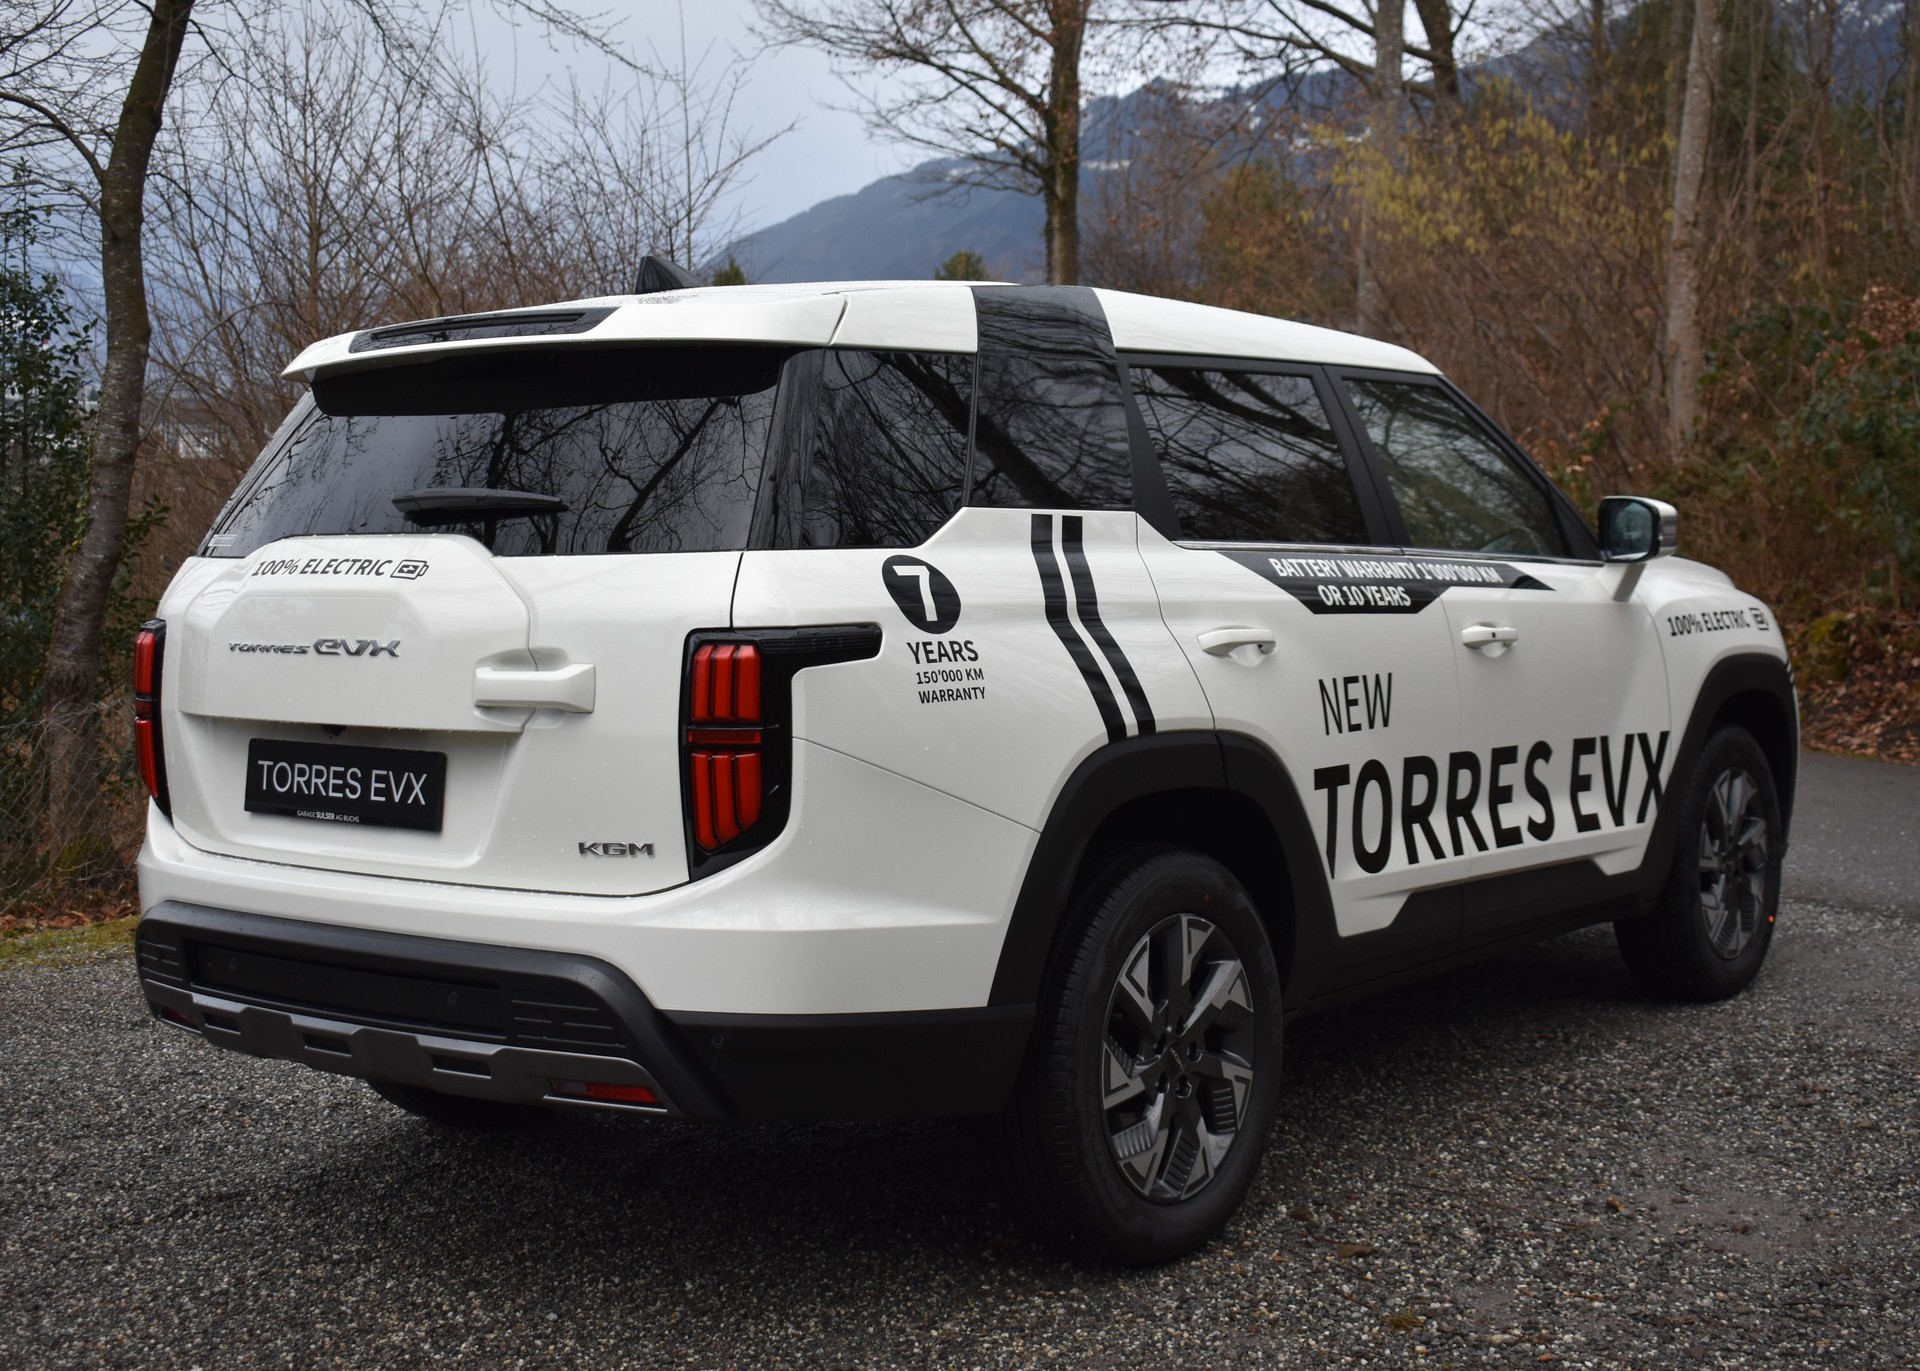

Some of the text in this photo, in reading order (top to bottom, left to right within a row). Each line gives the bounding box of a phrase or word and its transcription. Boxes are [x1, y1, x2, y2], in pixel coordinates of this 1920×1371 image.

[252, 558, 393, 577] 100% ELECTRIC
[1268, 557, 1339, 578] BATTERY
[1339, 559, 1421, 580] WARRANTY
[1480, 565, 1504, 583] KM
[892, 565, 938, 622] 7
[1317, 584, 1412, 607] OR 10 YEARS
[1667, 610, 1750, 636] 100% ELECTRIC
[228, 642, 310, 655] TORRES
[906, 640, 979, 664] YEARS
[916, 668, 984, 685] 150'000 KM
[918, 687, 985, 704] WARRANTY
[1318, 672, 1393, 736] NEW
[257, 760, 428, 805] TORRES EVX
[297, 810, 316, 818] GARAGE
[316, 811, 335, 820] SULSER
[343, 815, 360, 823] BUCHS
[1313, 730, 1671, 880] TORRES EVX
[578, 842, 655, 857] KGM
